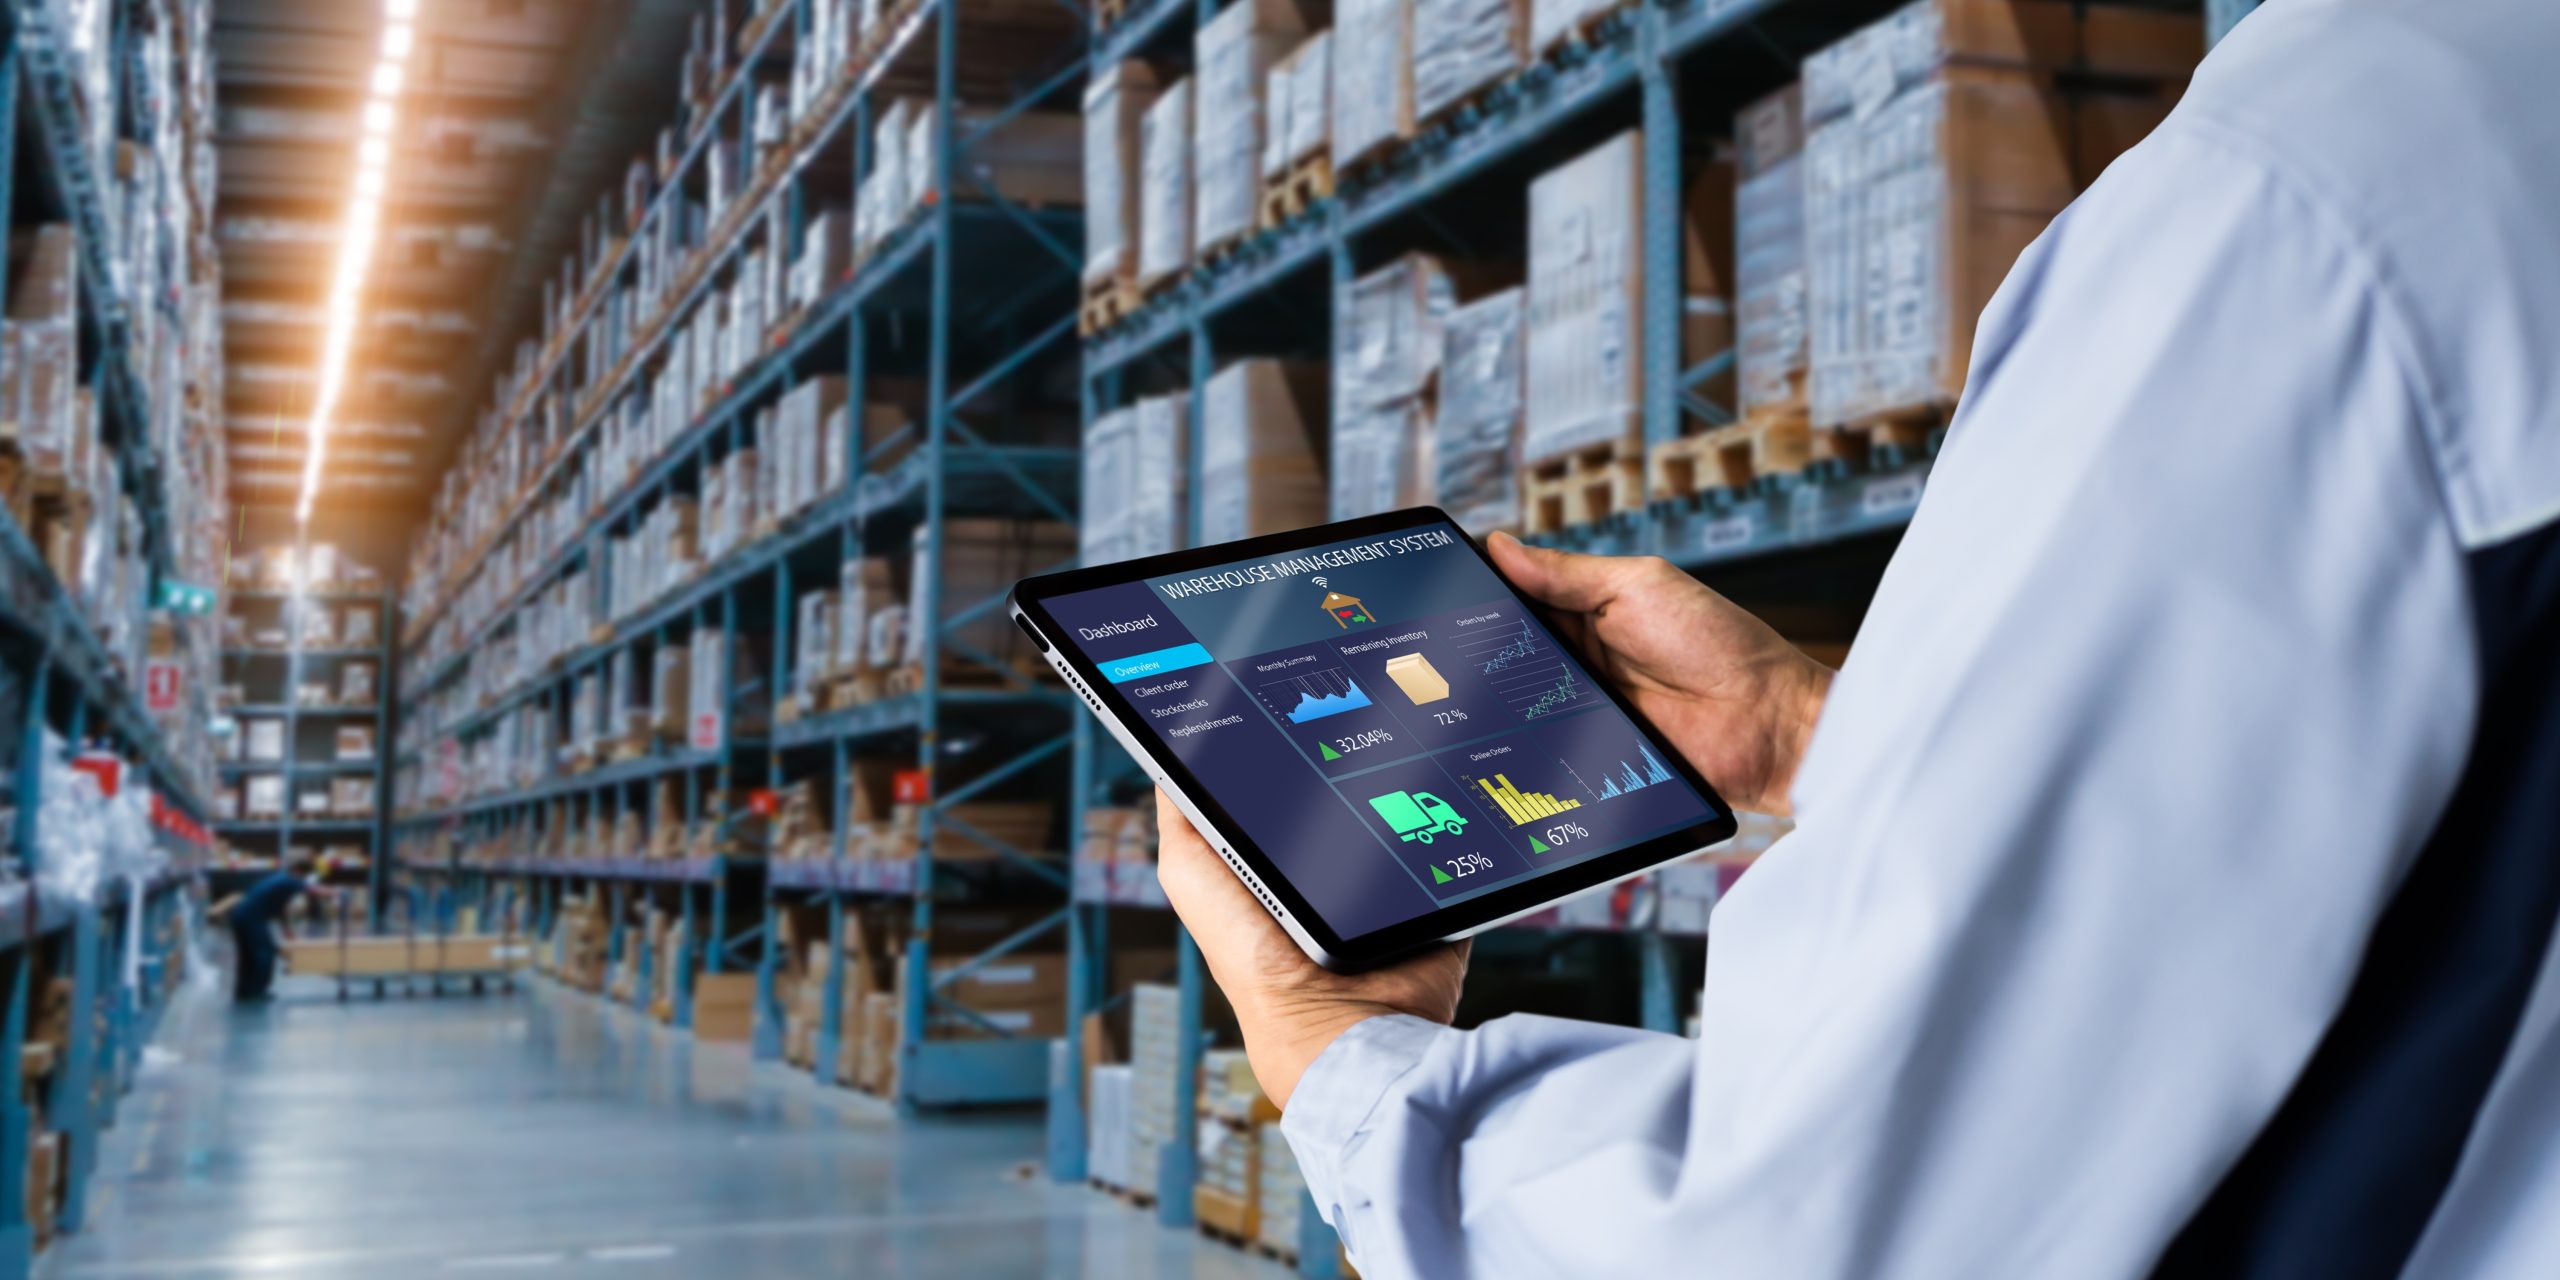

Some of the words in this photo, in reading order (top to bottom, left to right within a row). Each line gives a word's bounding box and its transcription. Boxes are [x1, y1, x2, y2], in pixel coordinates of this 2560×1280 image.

[1160, 565, 1275, 600] WAREHOUSE
[1272, 542, 1391, 578] MANAGEMENT
[1389, 530, 1454, 554] SYSTEM
[1078, 614, 1158, 641] Dashboard
[1456, 616, 1477, 627] Orders
[1485, 611, 1501, 620] week
[1341, 637, 1390, 656] Remaining
[1388, 630, 1428, 646] Inventory
[1114, 661, 1160, 677] Overview
[1257, 661, 1286, 673] Monthly
[1285, 654, 1317, 667] Summary
[1163, 680, 1189, 691] order
[1151, 699, 1209, 718] Stockchecks
[1169, 714, 1243, 737] Replenishments
[1335, 728, 1393, 753] 32.04%
[1470, 751, 1491, 762] Online
[1489, 746, 1512, 756] Orders
[1546, 821, 1589, 846] 67%
[1446, 851, 1494, 878] 25%
